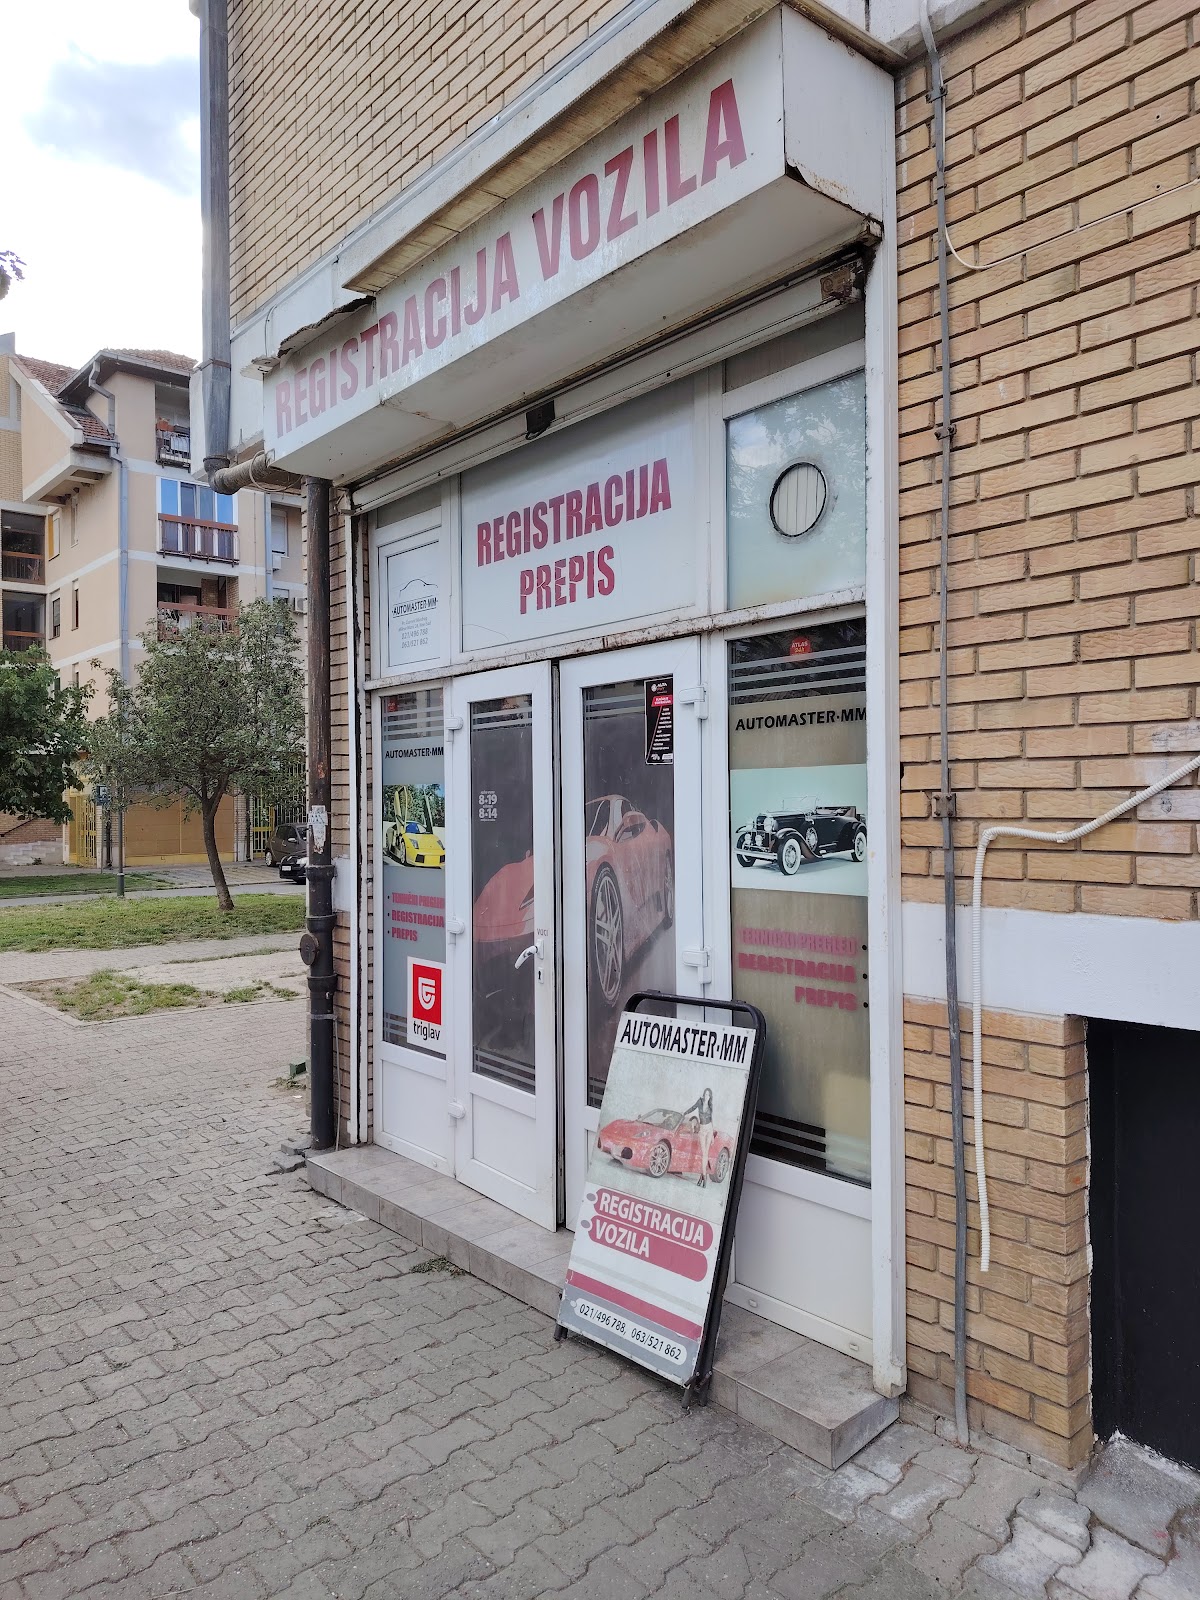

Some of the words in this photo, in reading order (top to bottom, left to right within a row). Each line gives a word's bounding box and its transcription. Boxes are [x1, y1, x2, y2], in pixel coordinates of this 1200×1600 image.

[275, 230, 521, 438] REGISTRACIJA
[531, 78, 747, 281] VOZILA
[476, 457, 672, 567] REGISTRACIJA
[519, 545, 615, 615] PREPIS
[392, 909, 445, 928] REGISTRACIJA
[392, 927, 418, 941] PREPIS
[738, 952, 857, 984] REGISTRACIJA
[794, 985, 858, 1012] PREPIS
[413, 1020, 440, 1041] triglav
[595, 1219, 650, 1258] VOZILA
[600, 1192, 704, 1247] REGISTRACIJA
[579, 1303, 610, 1326] 021/496
[631, 1327, 664, 1352] 063/521
[664, 1343, 681, 1361] 862
